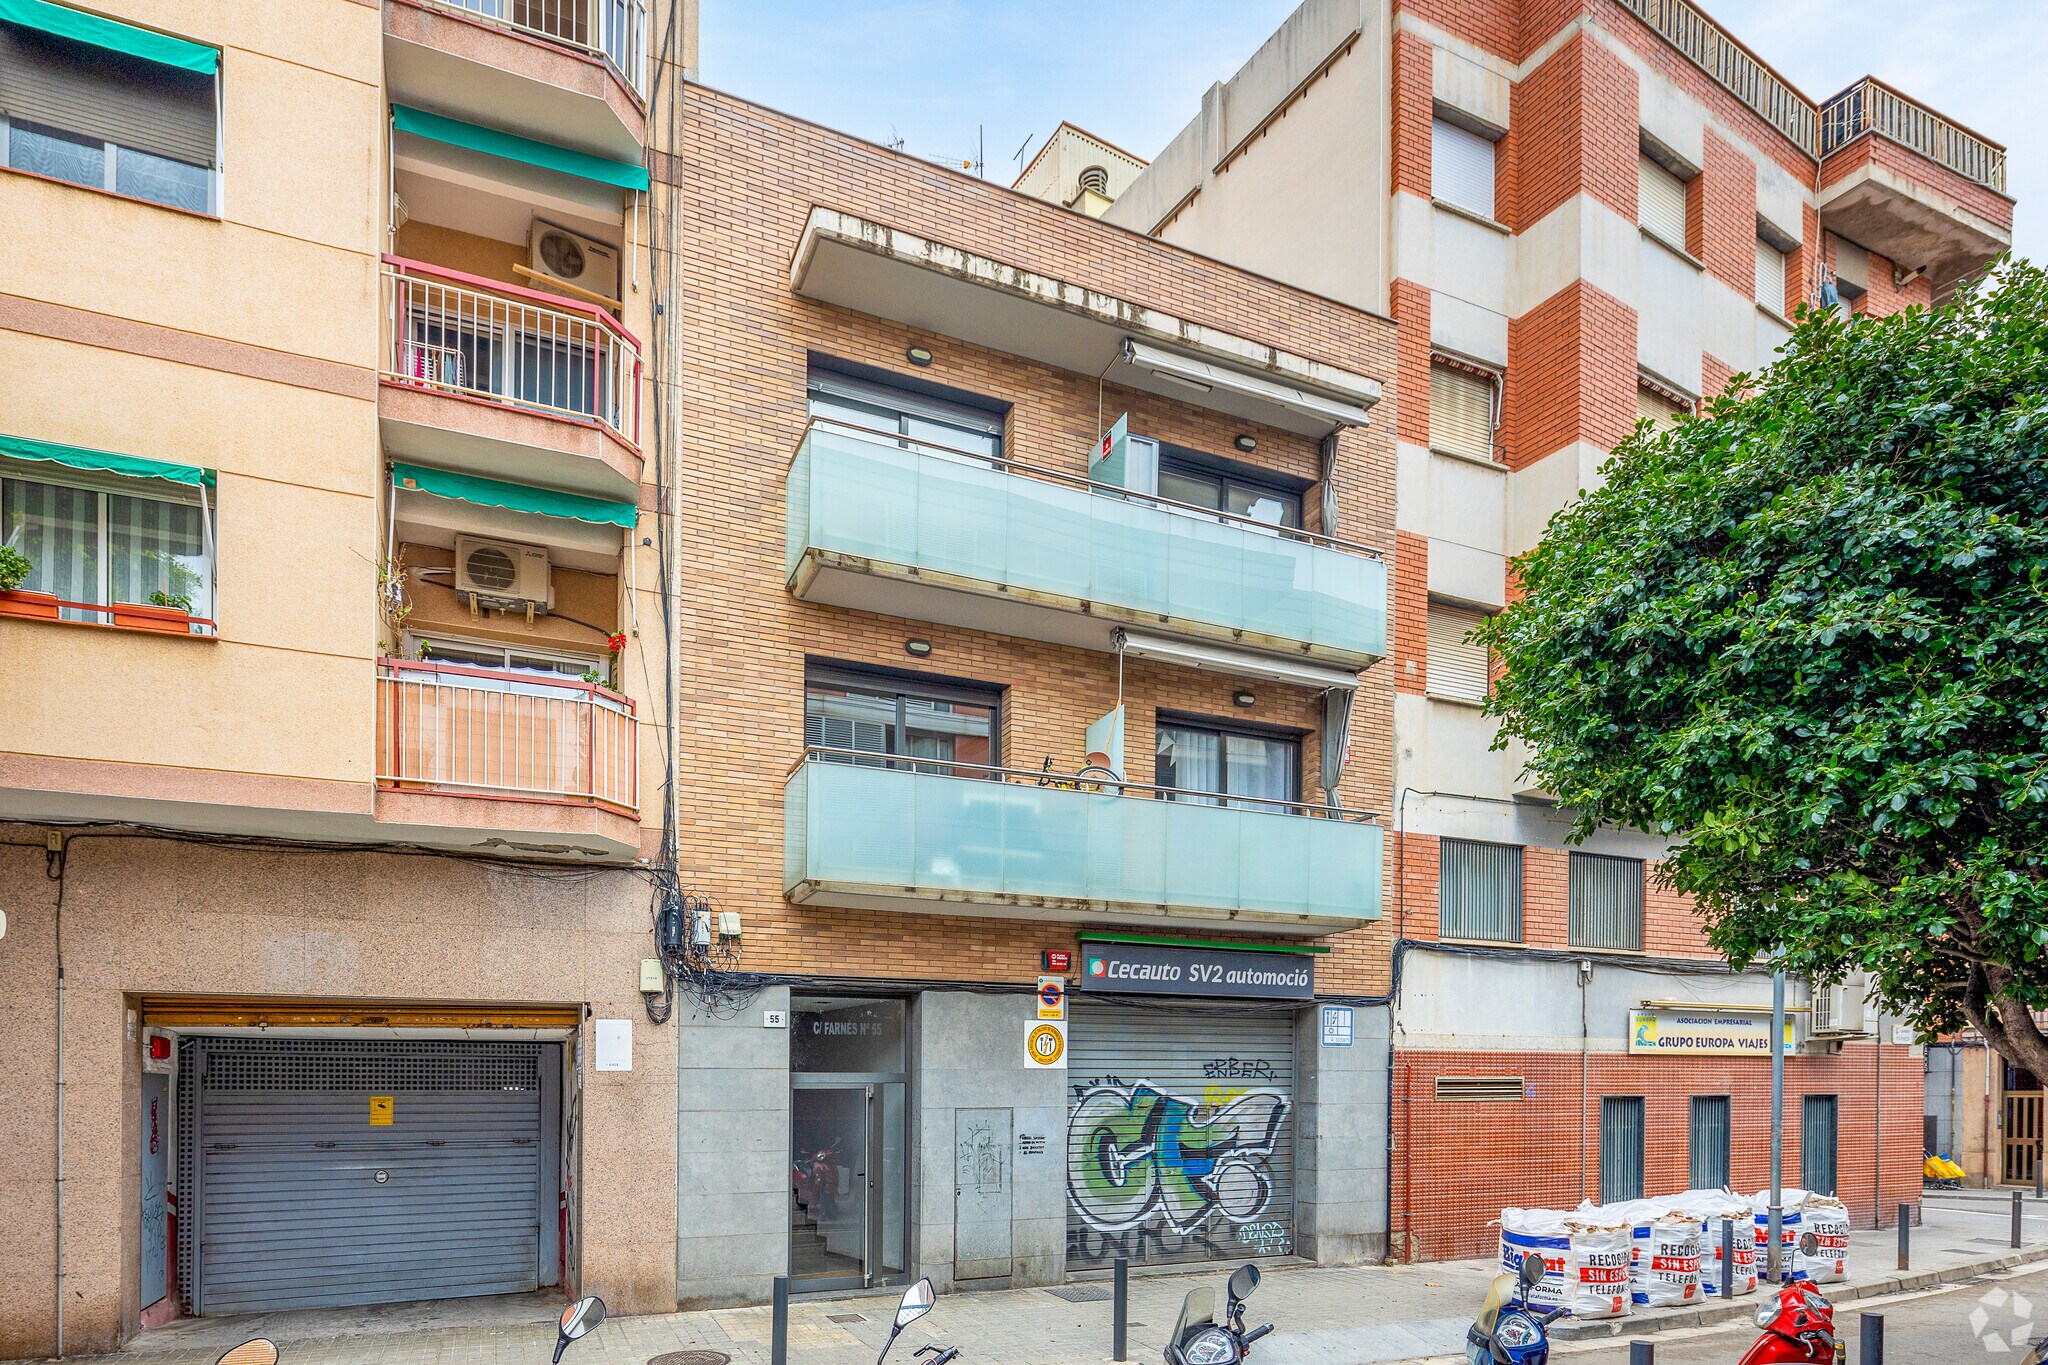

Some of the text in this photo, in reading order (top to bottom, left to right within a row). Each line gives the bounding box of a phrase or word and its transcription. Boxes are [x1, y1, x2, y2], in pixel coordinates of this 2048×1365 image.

[1108, 960, 1308, 987] Cecauto SV2 automoció
[769, 1014, 780, 1023] 55
[1714, 1018, 1752, 1026] EMPRESARIAL
[813, 1021, 822, 1035] C/
[824, 1021, 857, 1036] FARNÉS
[871, 1023, 882, 1036] 55
[1658, 1037, 1768, 1050] GRUPO EUROPA VIAJES
[1660, 1258, 1681, 1270] SIN
[1588, 1269, 1607, 1281] SIN
